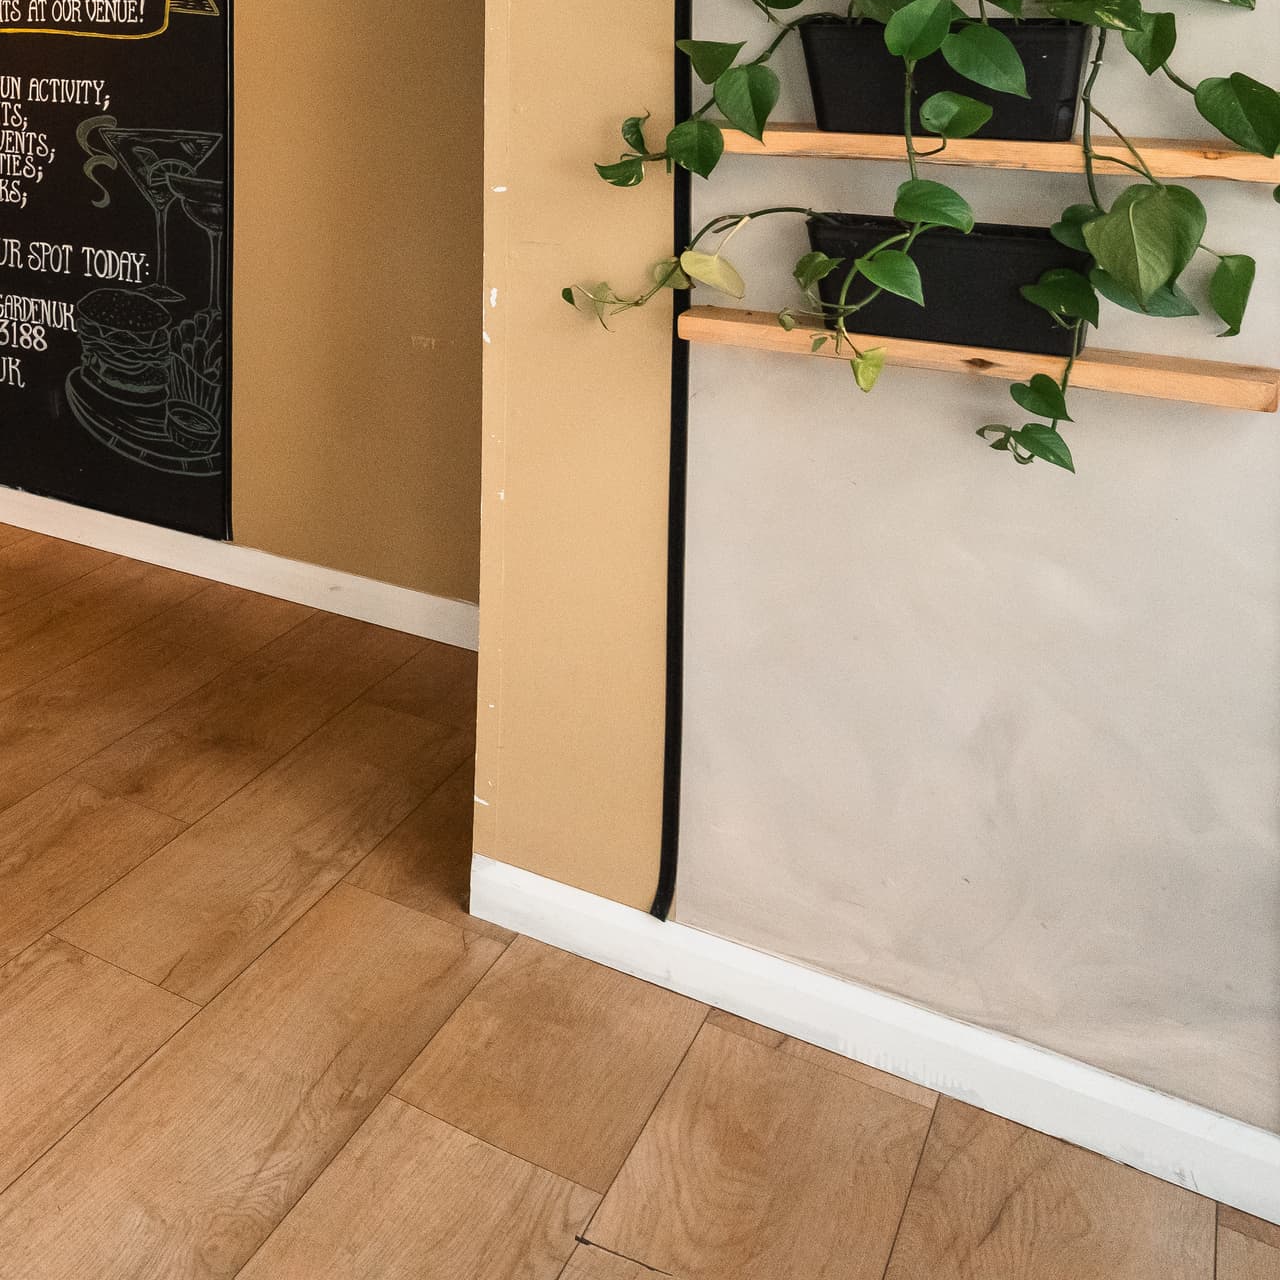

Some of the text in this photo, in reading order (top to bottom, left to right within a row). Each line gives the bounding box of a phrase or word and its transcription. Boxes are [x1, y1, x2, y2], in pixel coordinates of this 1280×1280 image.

[28, 0, 48, 23] AT
[51, 0, 82, 22] OUR
[84, 0, 146, 24] VENUE!
[27, 78, 112, 111] ACTIVITY;
[27, 240, 74, 275] SPOT
[81, 246, 151, 284] TODAY:
